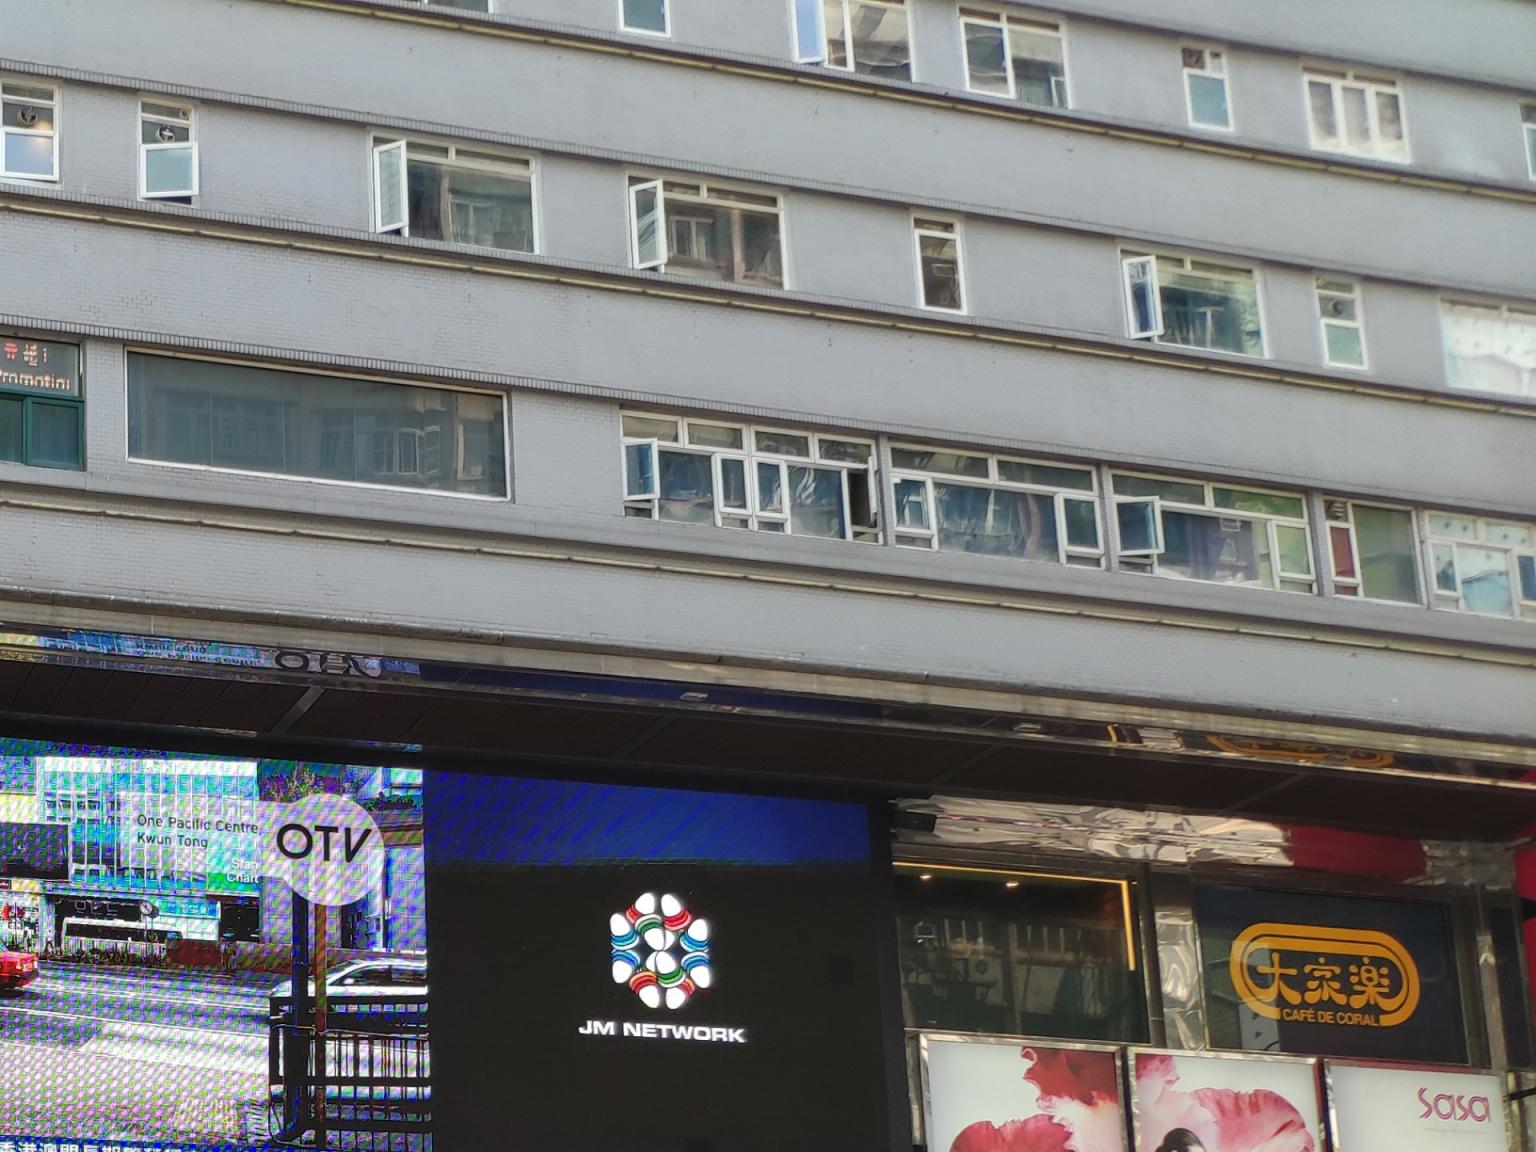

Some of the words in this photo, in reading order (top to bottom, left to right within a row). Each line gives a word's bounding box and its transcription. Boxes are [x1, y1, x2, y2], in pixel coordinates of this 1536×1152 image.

[137, 814, 163, 827] One
[168, 816, 211, 830] Pacific
[215, 819, 259, 833] Centre
[137, 832, 172, 845] Kwun
[178, 834, 208, 849] Tong
[276, 823, 372, 863] OTV
[1318, 1011, 1333, 1022] DE
[1336, 1012, 1379, 1026] CORAL
[578, 1019, 615, 1036] JM
[622, 1021, 746, 1043] NETWORK
